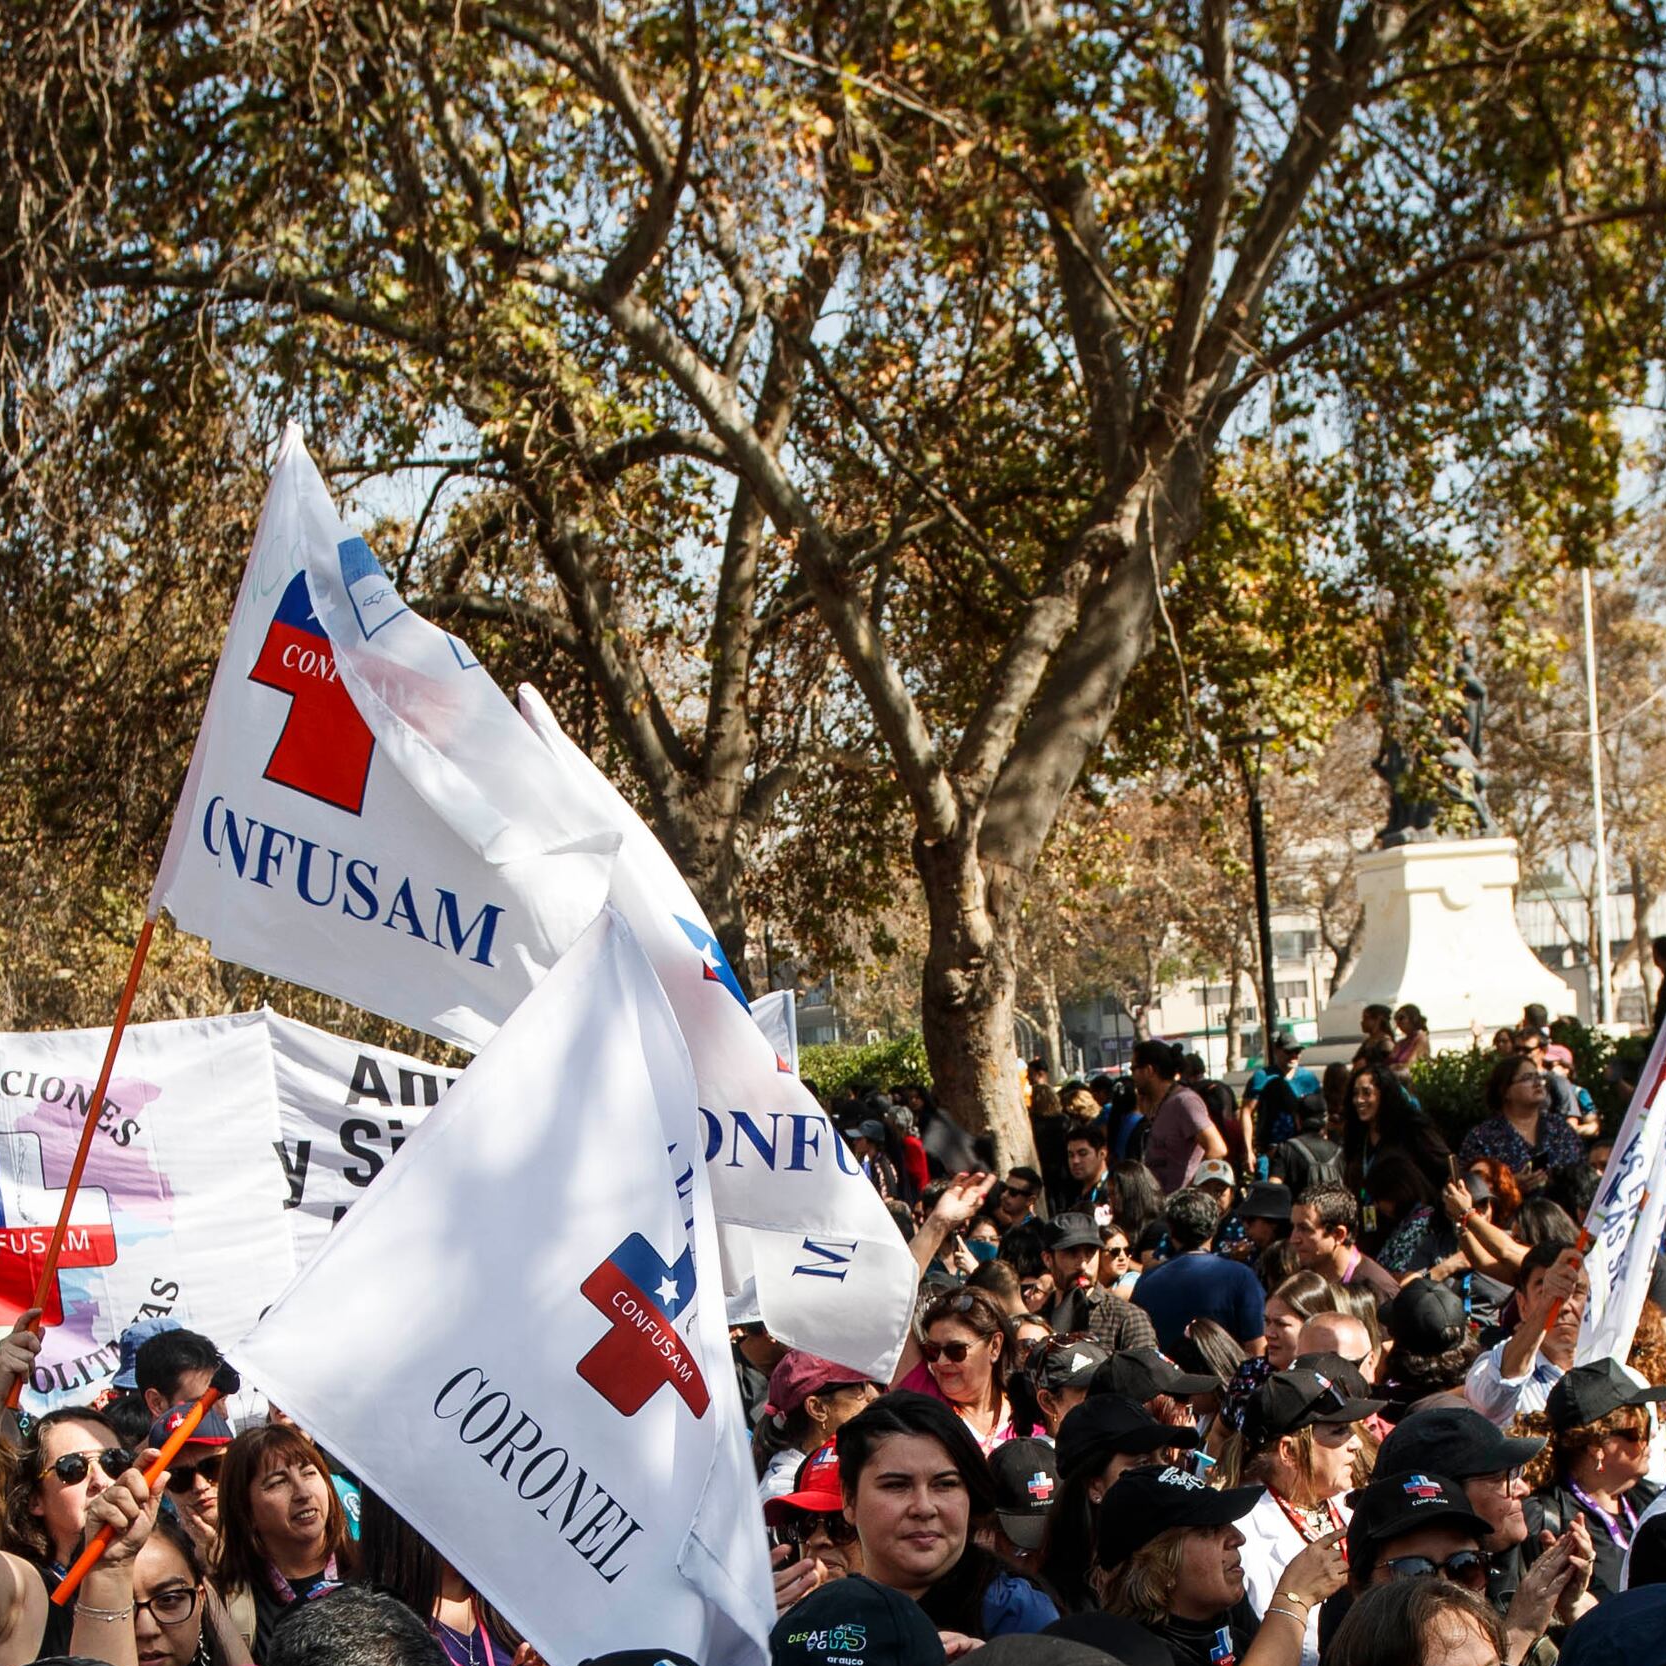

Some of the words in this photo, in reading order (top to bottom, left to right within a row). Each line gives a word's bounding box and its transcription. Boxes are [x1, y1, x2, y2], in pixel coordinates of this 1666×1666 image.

[612, 1290, 693, 1383] CONFUSAM
[433, 1366, 645, 1585] CORONEL
[826, 1655, 865, 1666] arauco
